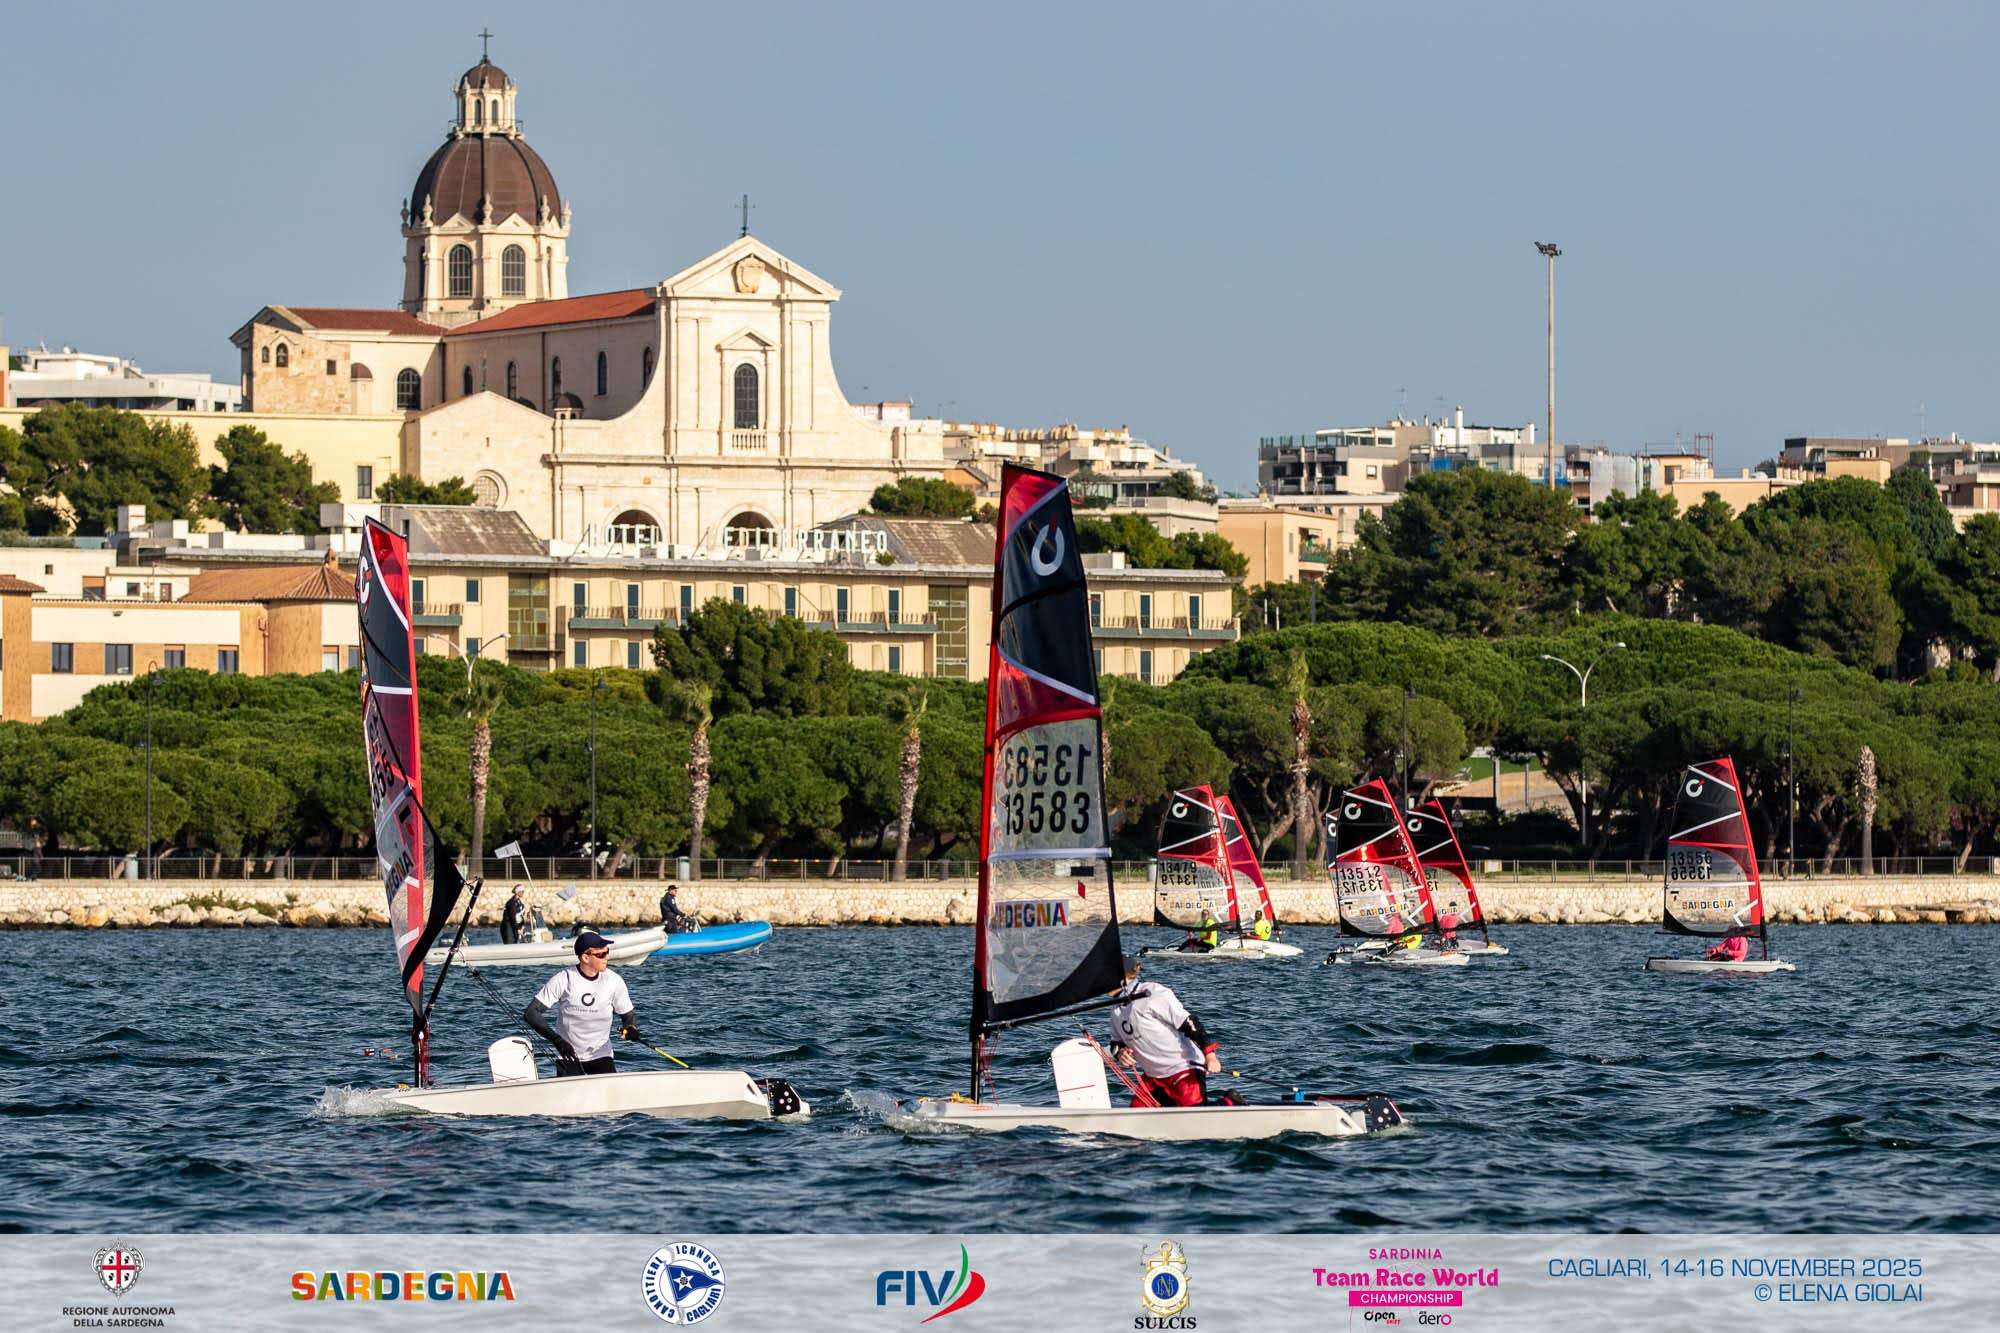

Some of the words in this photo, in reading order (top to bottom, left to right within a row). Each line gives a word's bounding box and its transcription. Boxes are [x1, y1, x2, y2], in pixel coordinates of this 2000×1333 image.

[707, 526, 888, 553] EDITERRANEO
[1005, 791, 1091, 836] 13583
[1340, 865, 1381, 880] 13512
